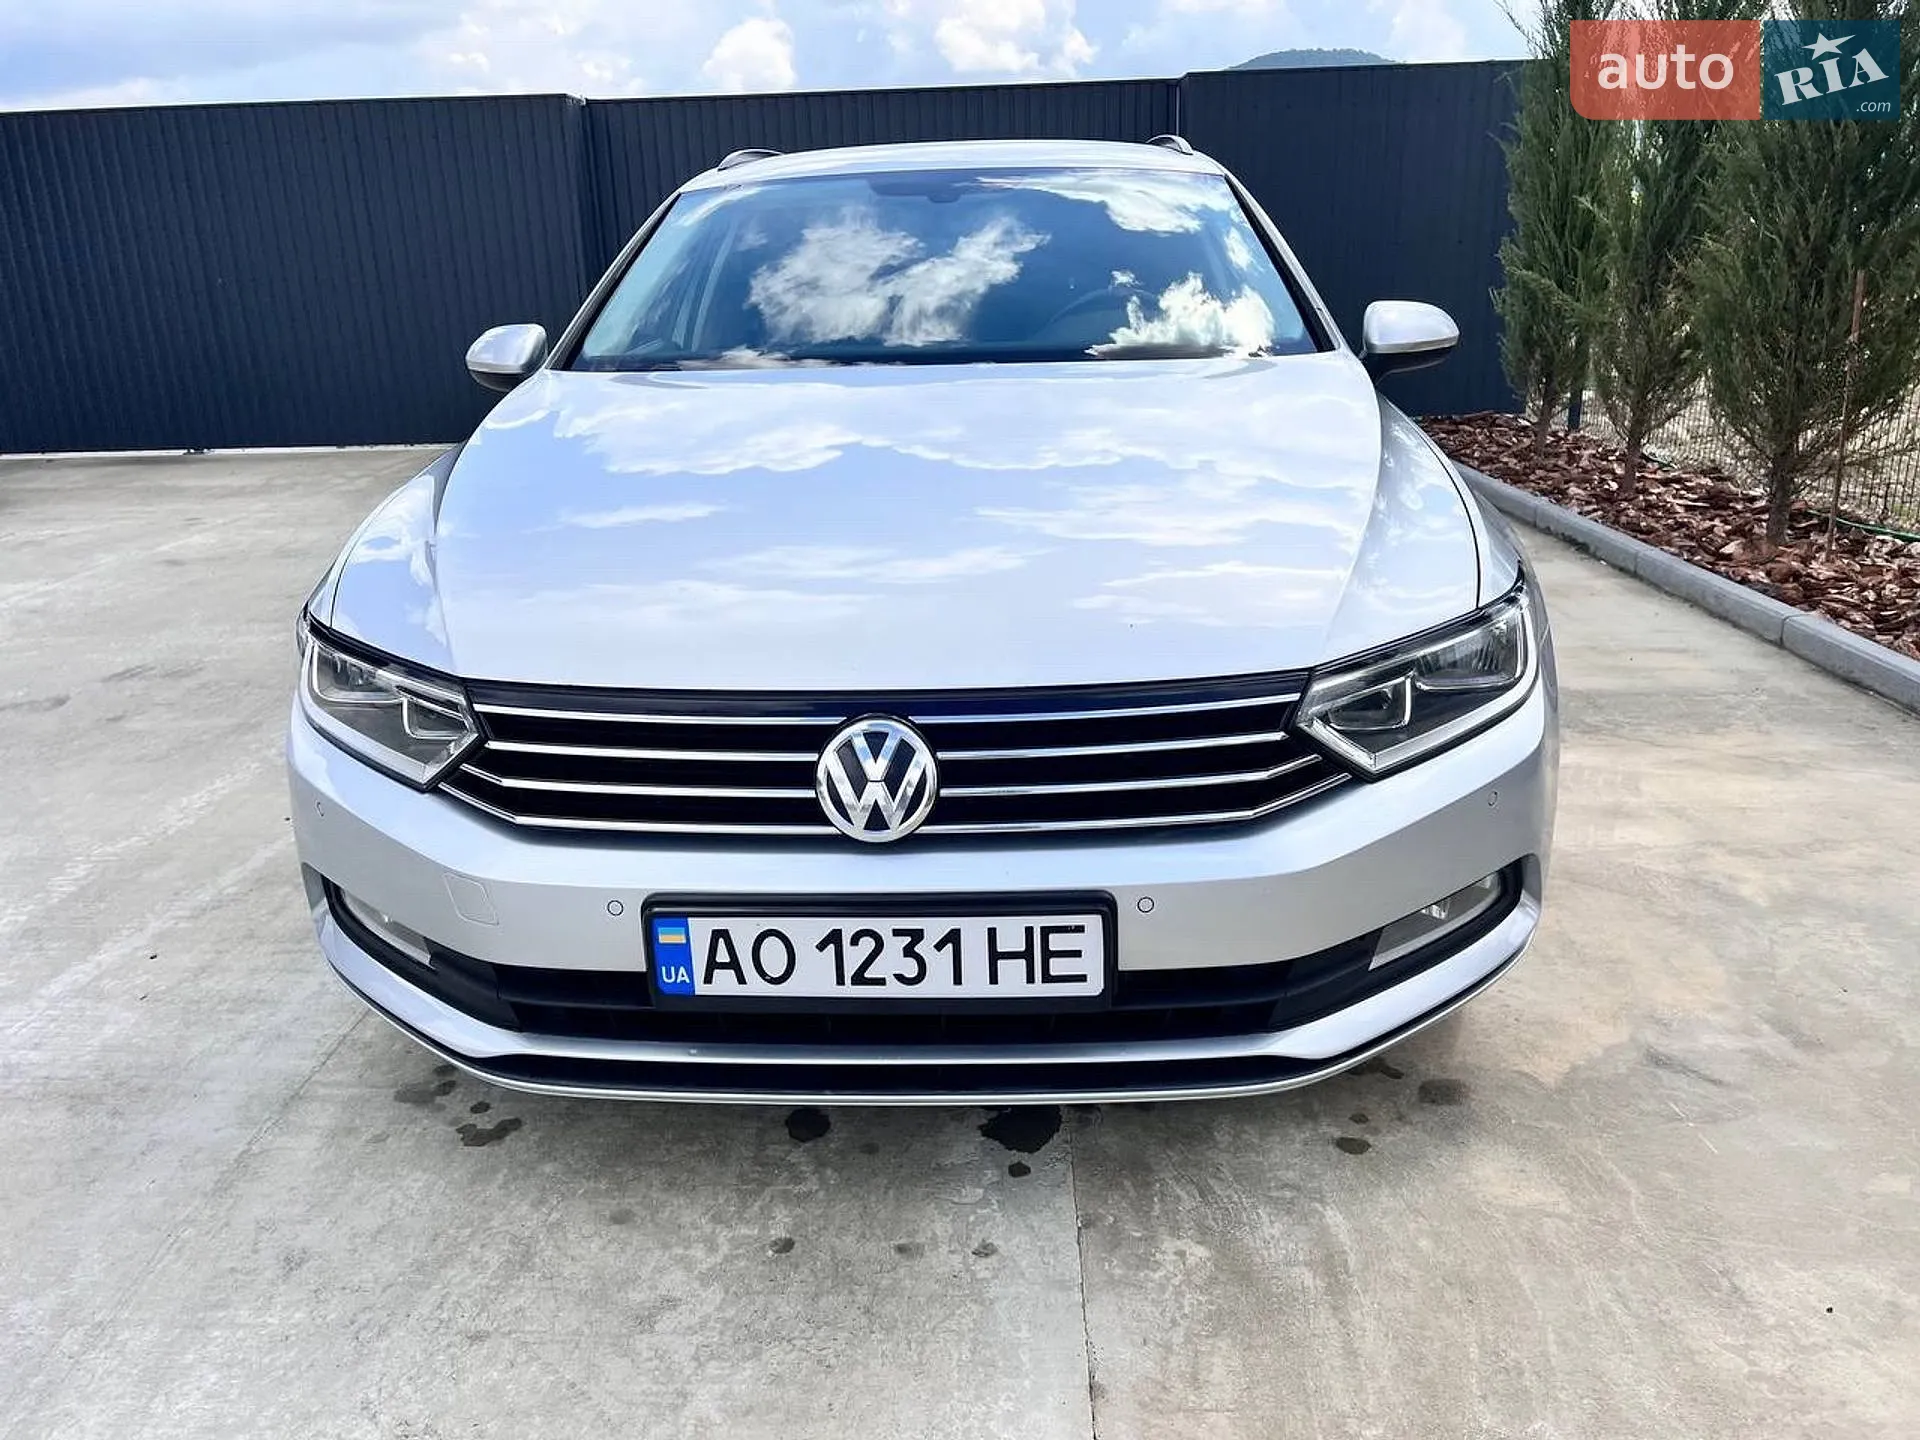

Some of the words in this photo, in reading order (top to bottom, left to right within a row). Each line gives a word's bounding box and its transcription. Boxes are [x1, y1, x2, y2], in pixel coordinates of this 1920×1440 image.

[661, 965, 691, 984] UA
[702, 928, 797, 986] AO
[814, 927, 963, 987] 1231
[986, 924, 1088, 985] HE
